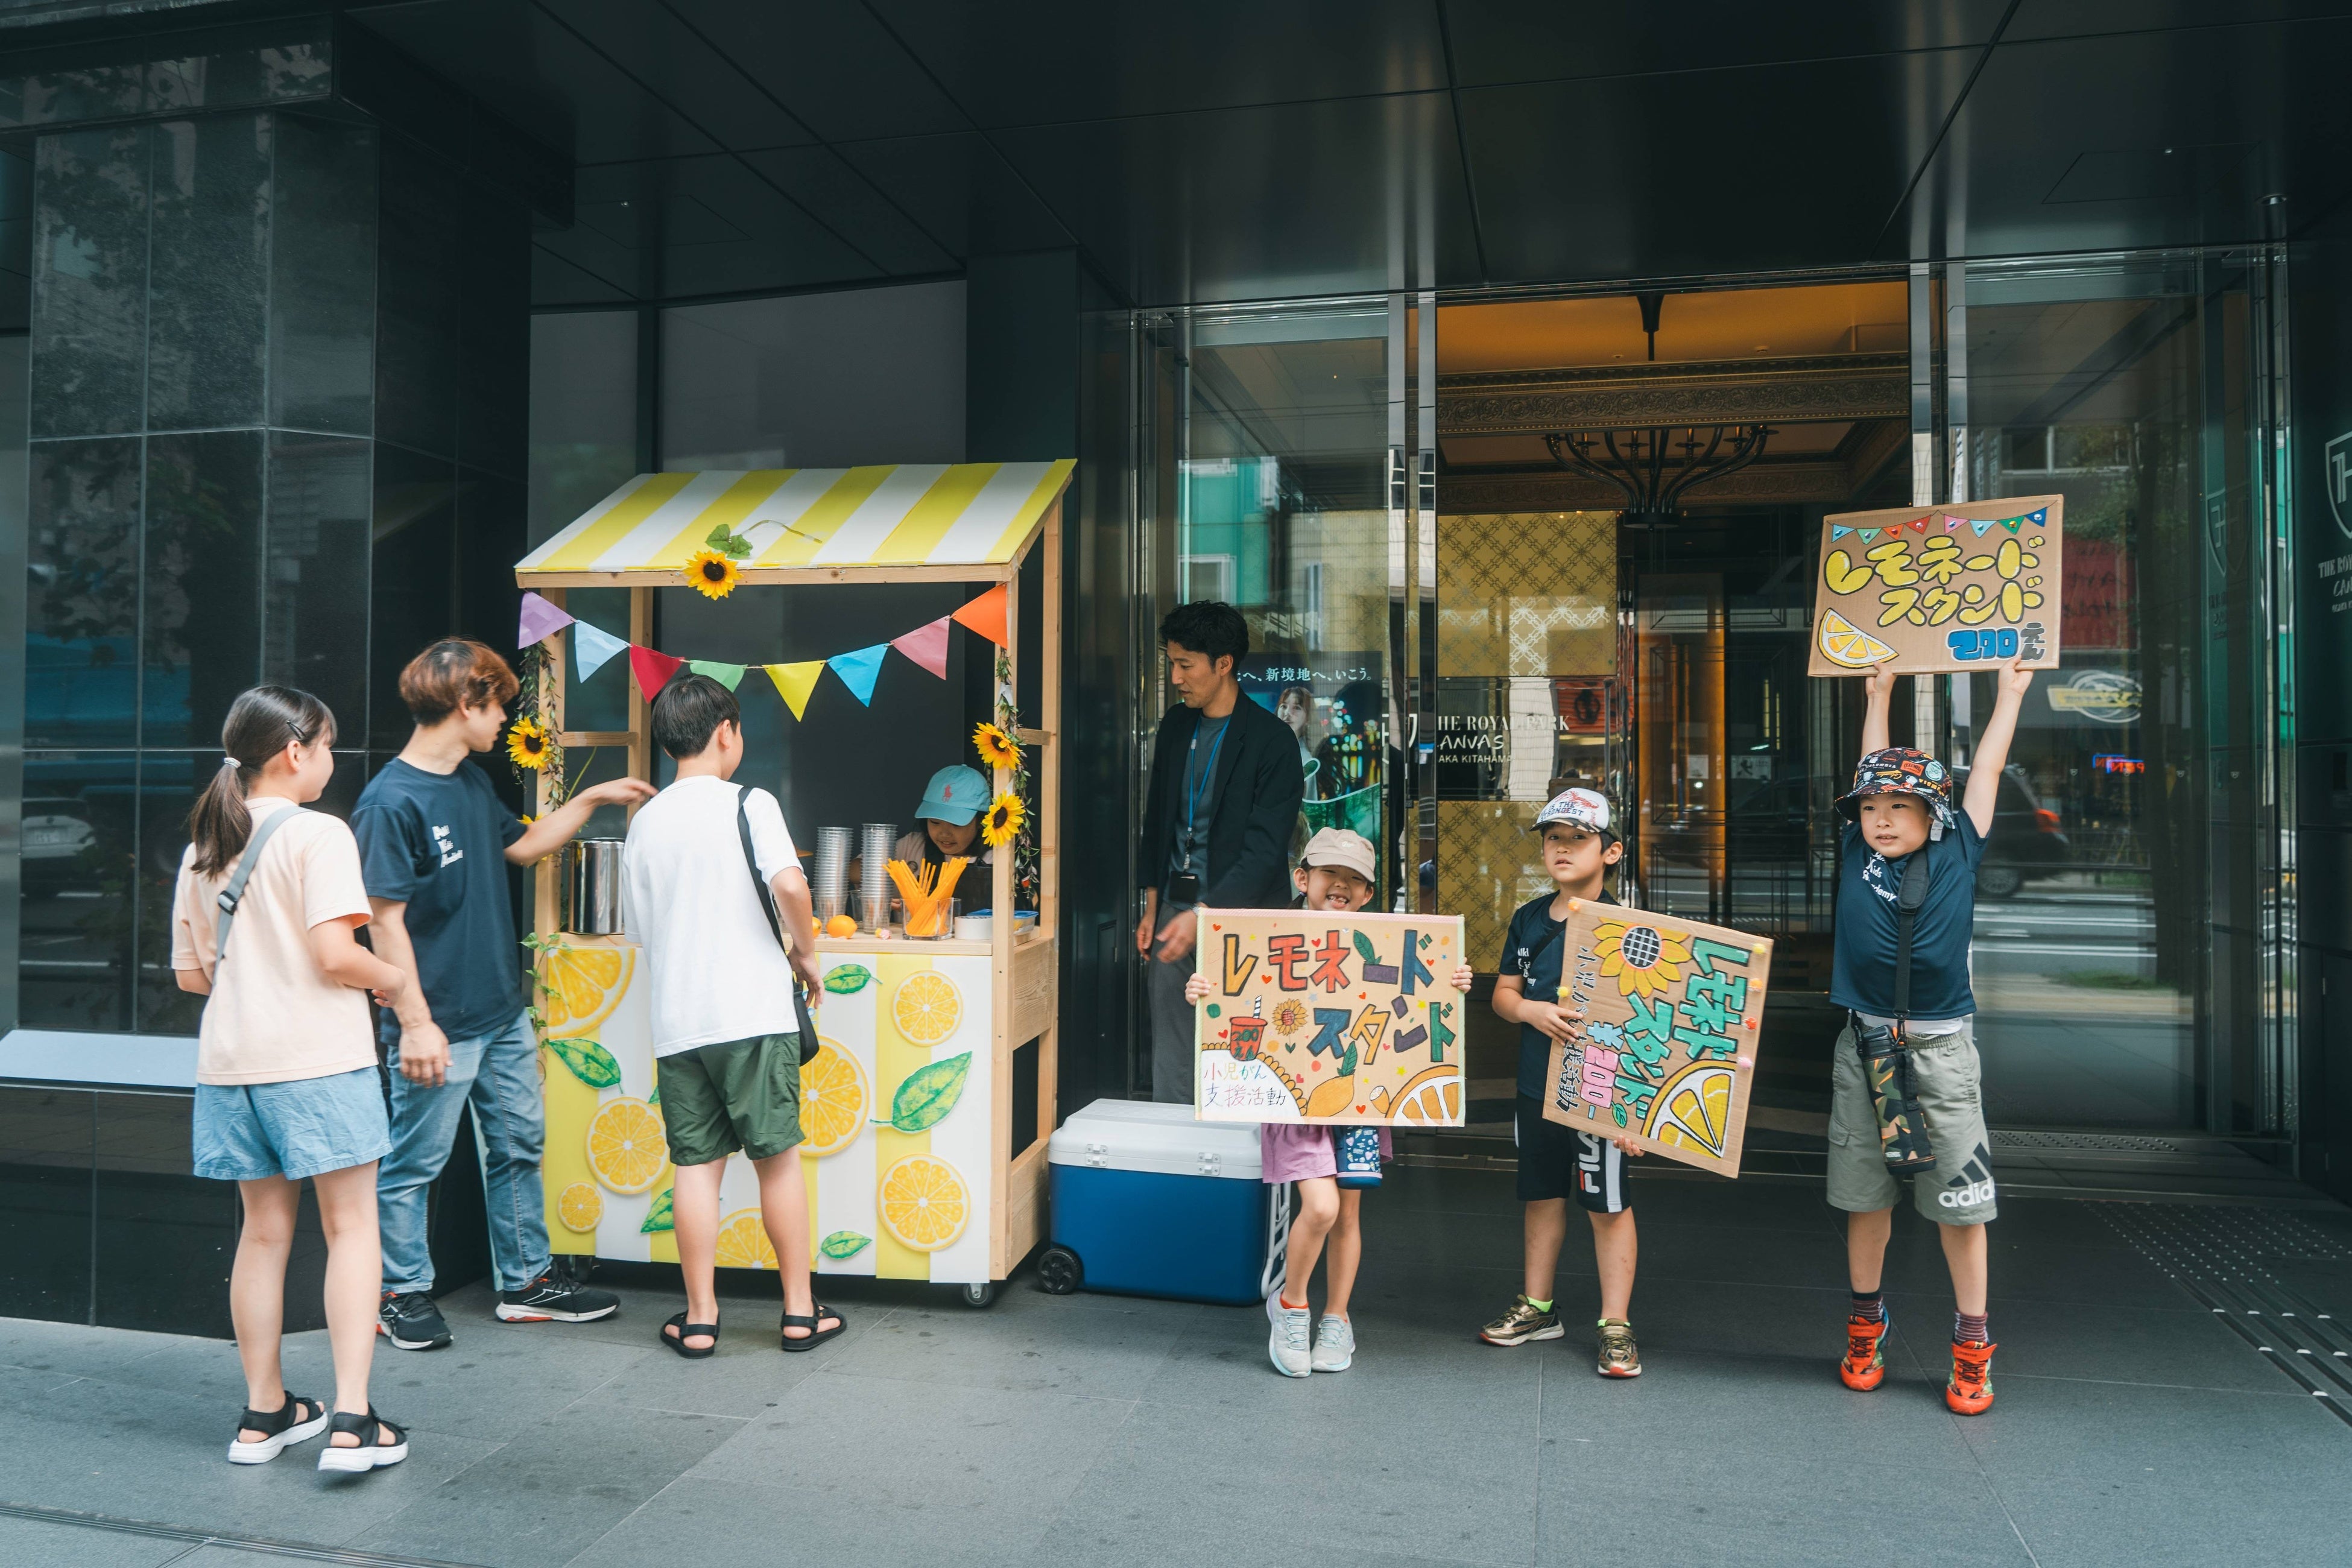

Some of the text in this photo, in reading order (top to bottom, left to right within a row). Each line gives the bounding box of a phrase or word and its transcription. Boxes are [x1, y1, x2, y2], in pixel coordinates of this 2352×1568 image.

[1824, 535, 2046, 595] レモネード
[1877, 575, 2044, 627] スタンド
[1237, 667, 1371, 682] へ、新境地へ、いこう。
[1438, 715, 1461, 731] HE
[1437, 734, 1505, 750] ANVAS
[1438, 754, 1458, 763] AKA
[1223, 929, 1434, 996] レモネード
[1306, 994, 1456, 1065] スタンド
[1614, 992, 1675, 1120] スタンド
[1204, 1062, 1266, 1081] 小児がん
[1205, 1083, 1286, 1107] 支援活動
